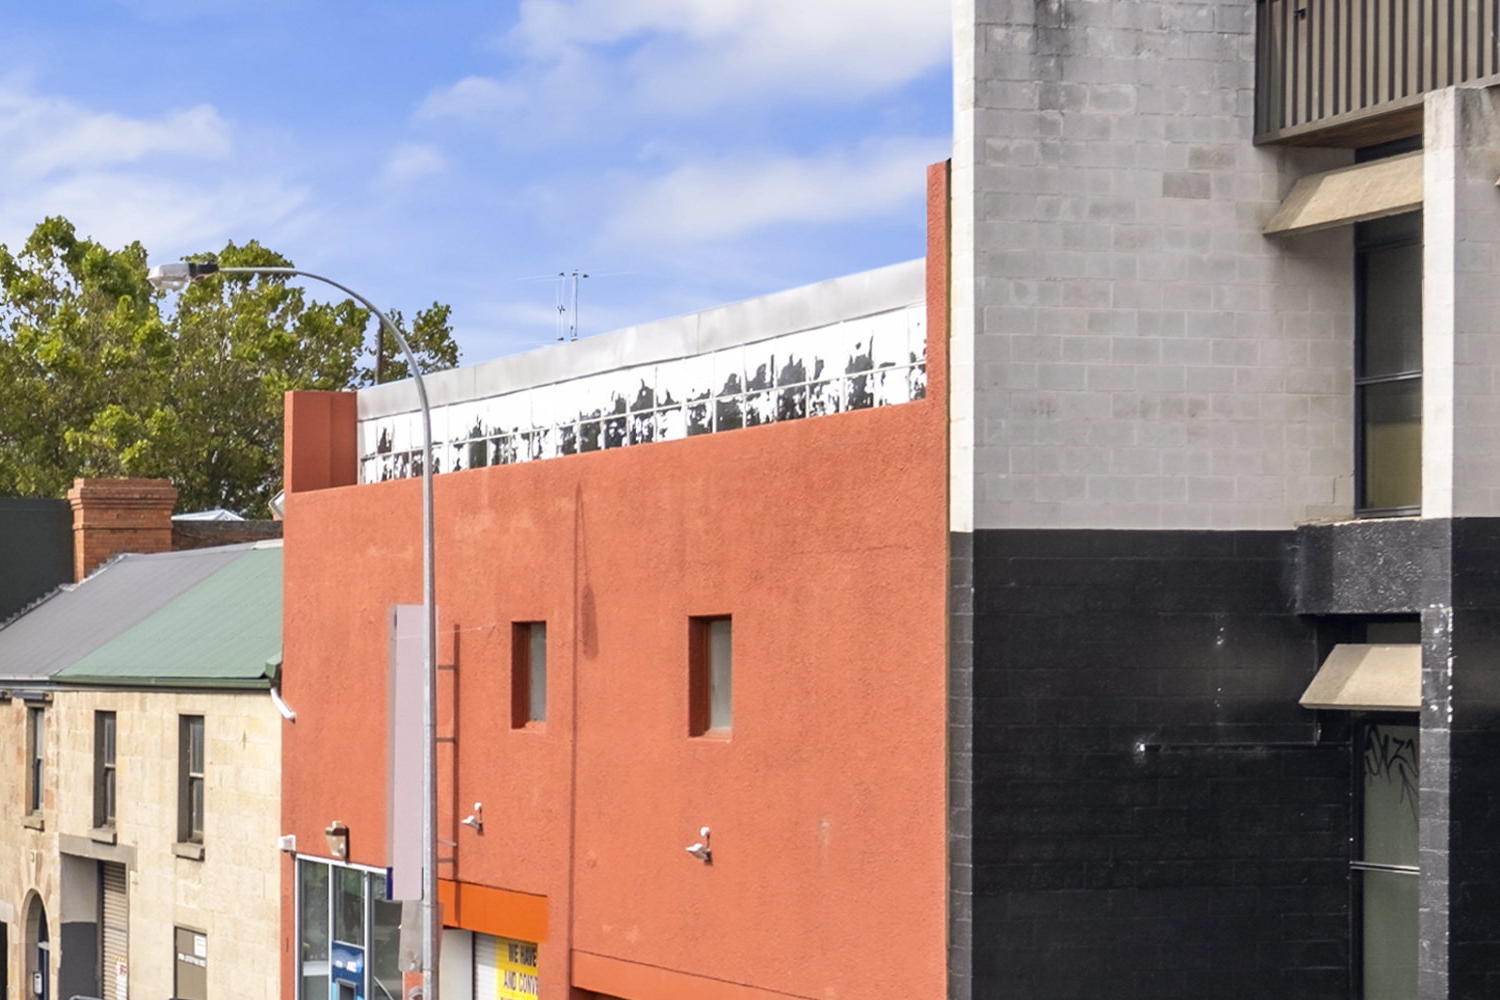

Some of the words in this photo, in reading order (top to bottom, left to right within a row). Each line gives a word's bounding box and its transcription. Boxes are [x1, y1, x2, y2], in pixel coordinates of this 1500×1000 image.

[507, 943, 518, 963] WE
[519, 944, 538, 968] HAVE
[504, 969, 517, 991] AND
